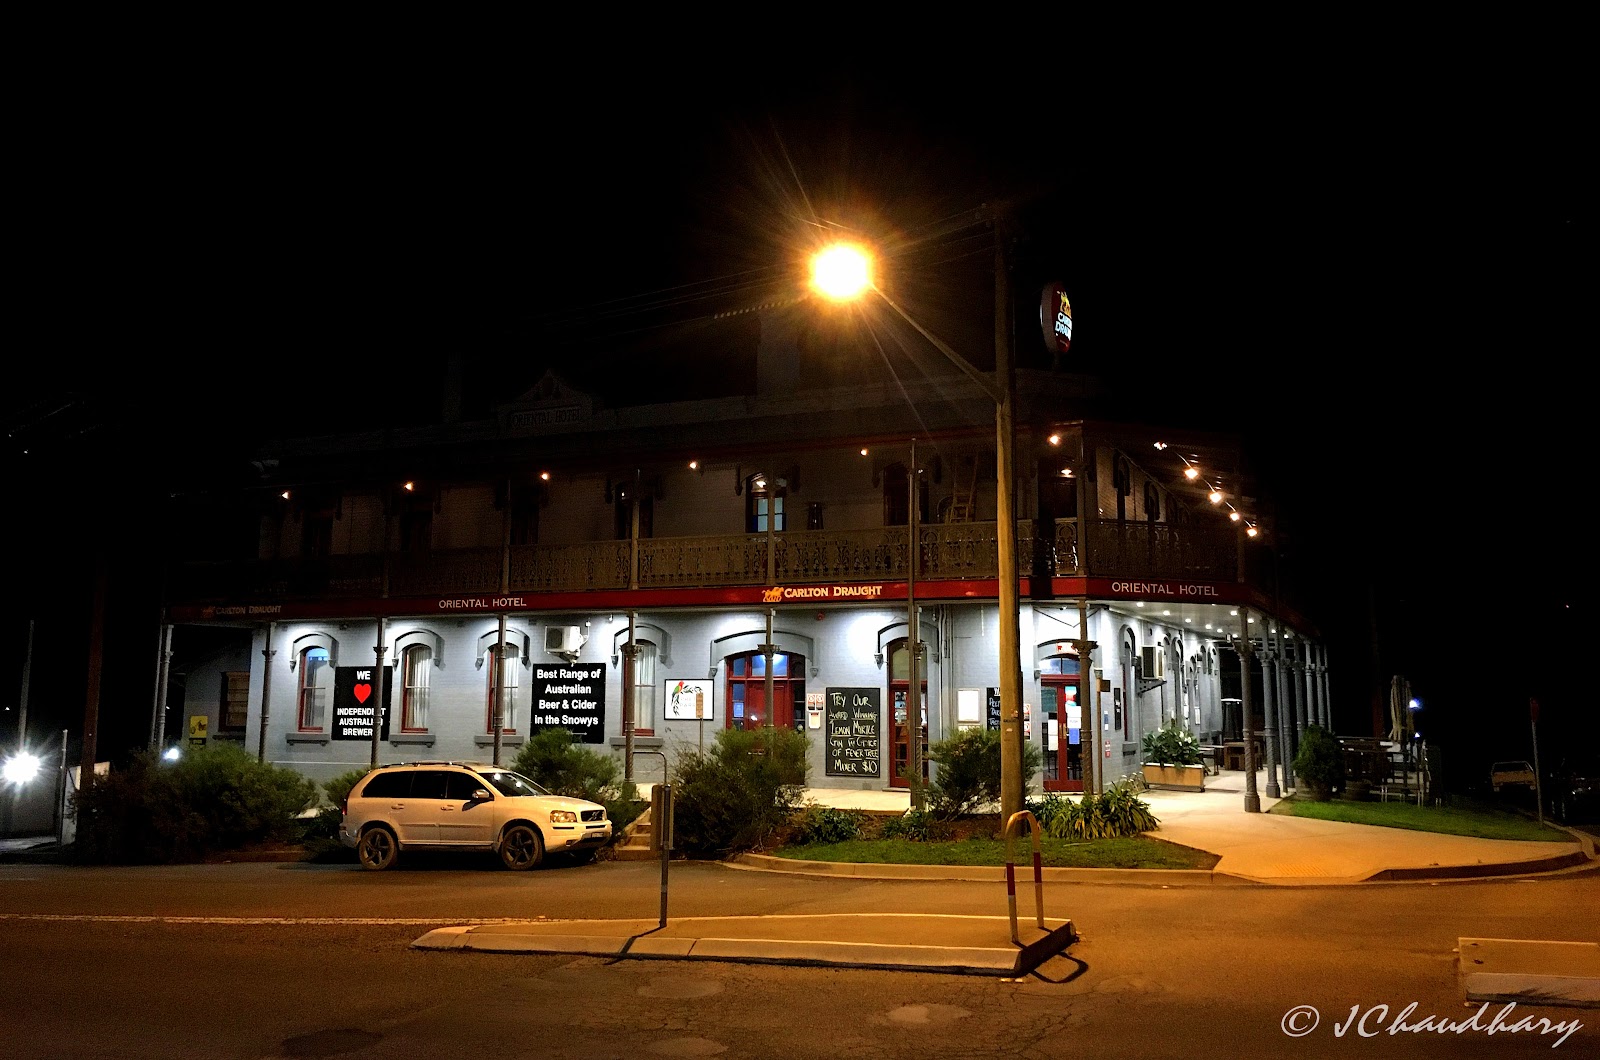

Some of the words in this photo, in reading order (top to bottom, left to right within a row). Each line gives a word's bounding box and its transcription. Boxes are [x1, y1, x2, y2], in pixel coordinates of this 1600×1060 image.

[784, 588, 828, 598] CARLTON
[833, 586, 882, 597] DRAUGHT
[1112, 582, 1174, 594] ORIENTAL
[1180, 584, 1218, 596] HOTEL
[439, 599, 488, 608] ORIENTAL
[492, 598, 527, 607] HOTEL
[216, 606, 246, 614] CARLTON
[249, 605, 281, 614] DRAUGHT
[356, 670, 371, 680] WE
[536, 669, 558, 679] Best
[560, 669, 589, 681] Range
[591, 669, 601, 678] of
[545, 684, 592, 694] Australian
[539, 699, 560, 709] Beer
[562, 699, 569, 709] &
[571, 699, 597, 709] Cider
[337, 708, 386, 716] INDEPENDT
[339, 718, 383, 726] AUSTRALI
[534, 715, 543, 724] in
[545, 715, 560, 724] the
[562, 715, 599, 727] Snowys
